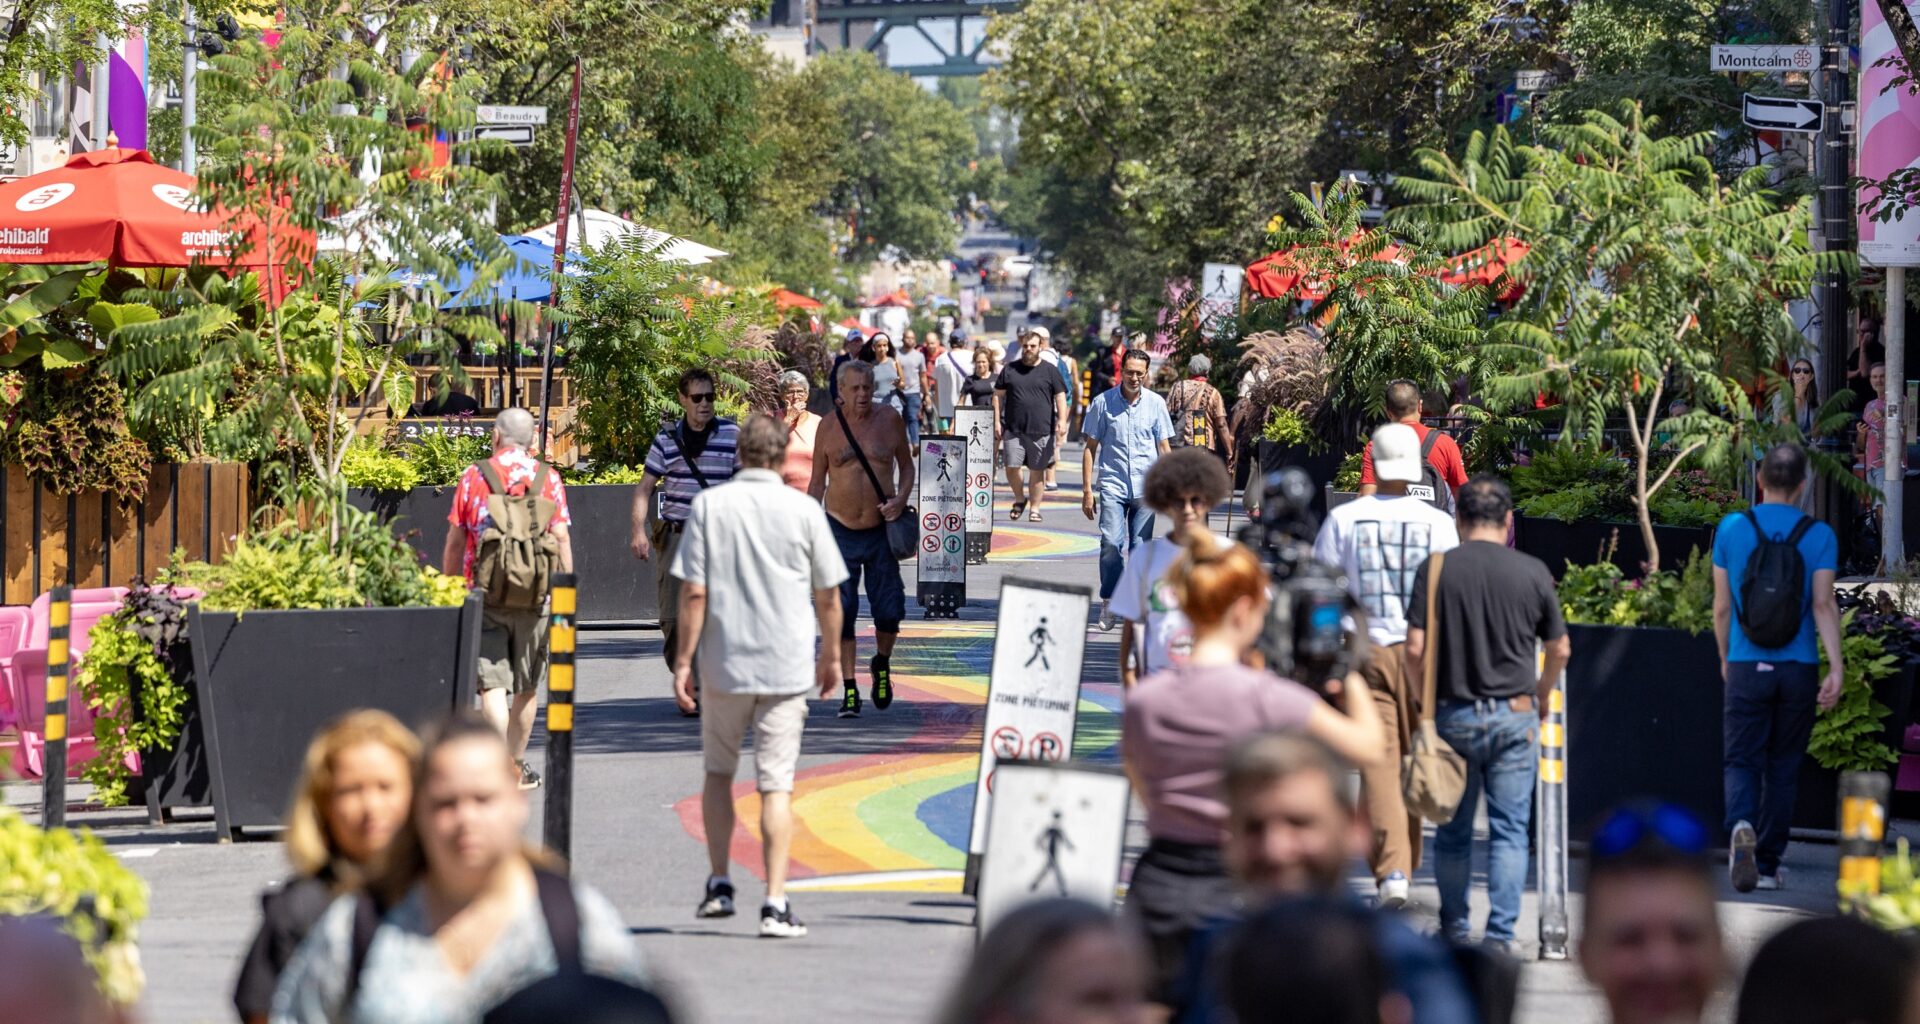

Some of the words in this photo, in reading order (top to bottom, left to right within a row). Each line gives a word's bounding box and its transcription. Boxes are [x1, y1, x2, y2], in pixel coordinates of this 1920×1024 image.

[1719, 54, 1792, 67] Montcalm
[495, 111, 540, 122] Beaudry
[406, 426, 417, 437] 2
[1405, 487, 1431, 497] VANS
